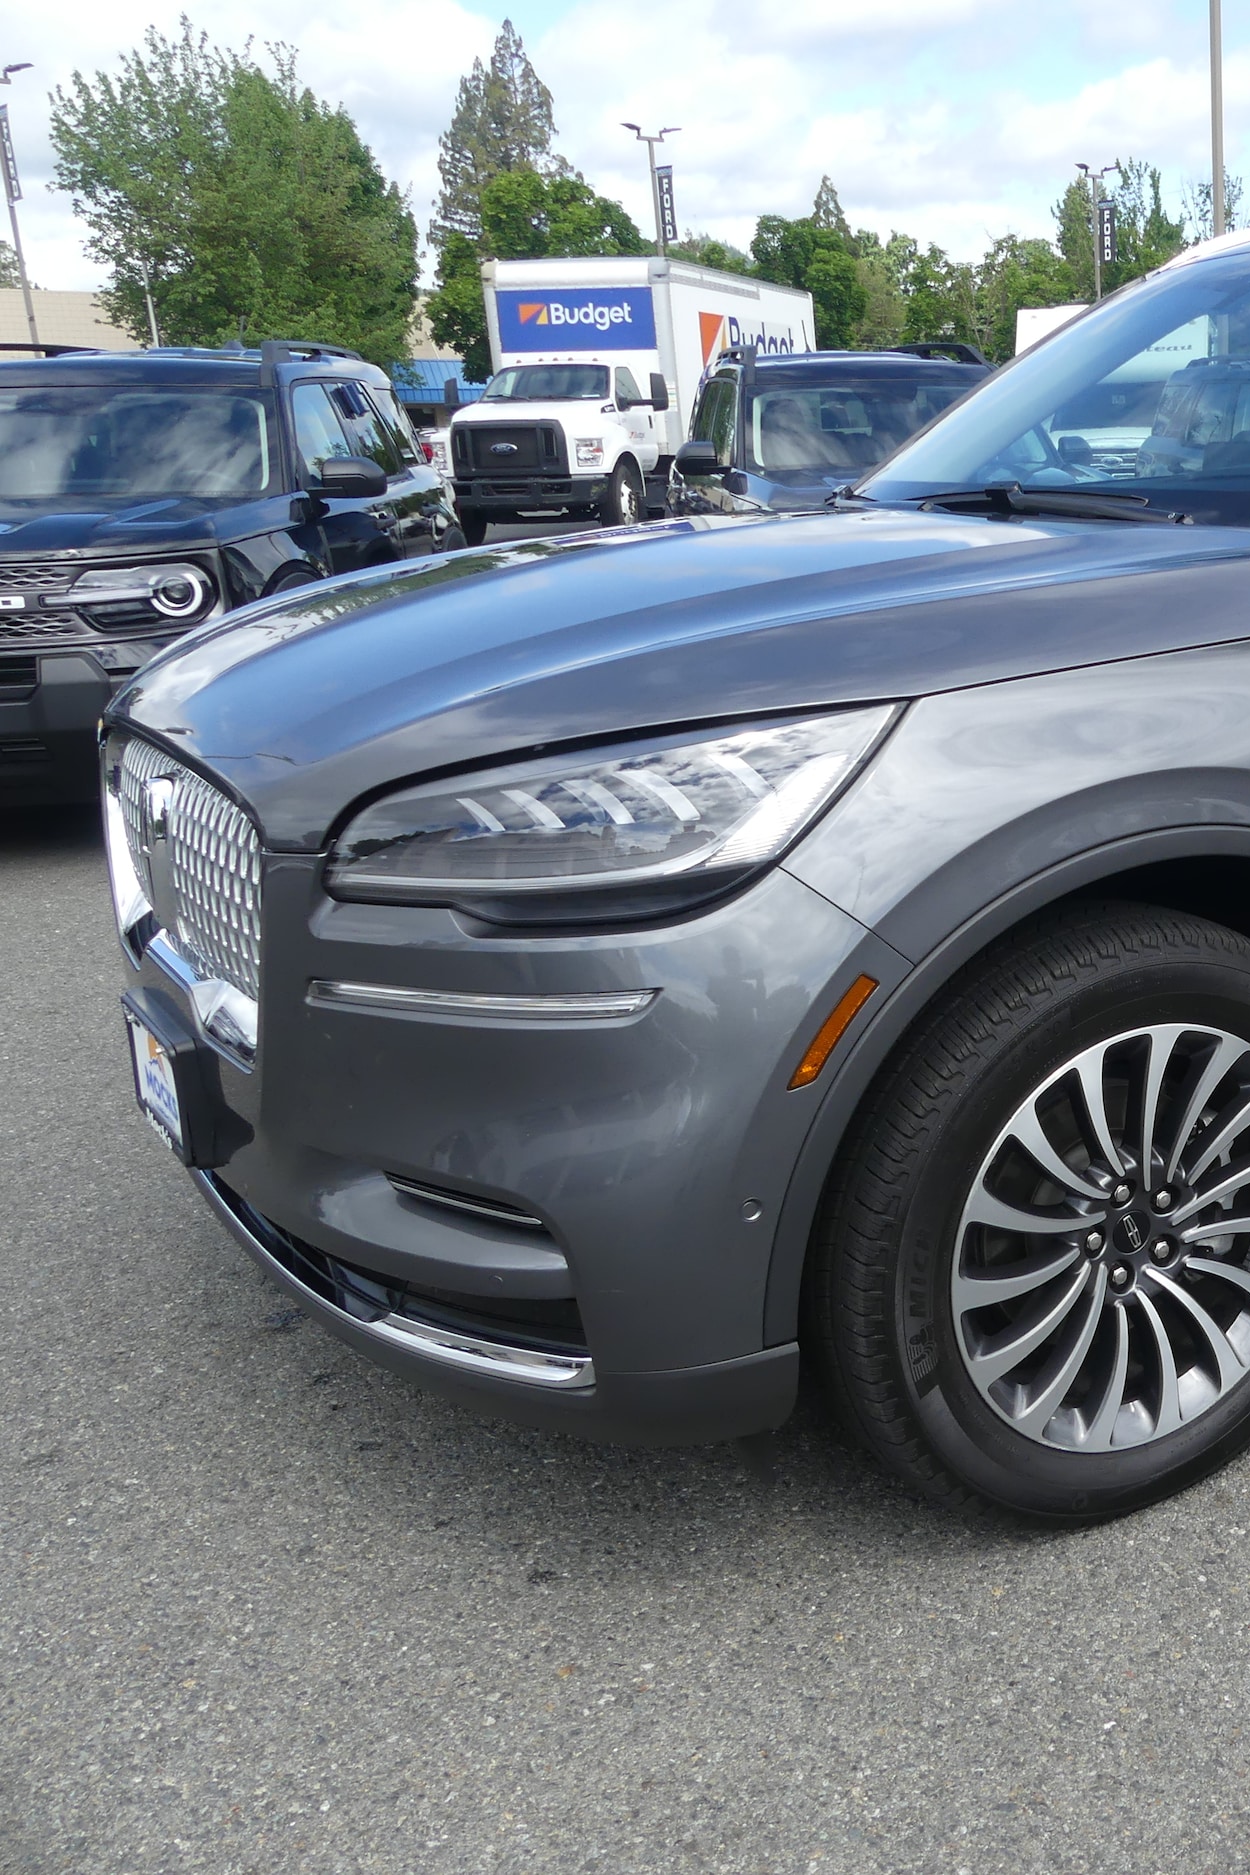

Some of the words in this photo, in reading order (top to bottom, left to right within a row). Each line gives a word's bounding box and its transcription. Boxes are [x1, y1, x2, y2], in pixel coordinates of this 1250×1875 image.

[662, 178, 673, 239] FORD
[1103, 210, 1111, 261] FORD
[550, 302, 632, 331] Budget
